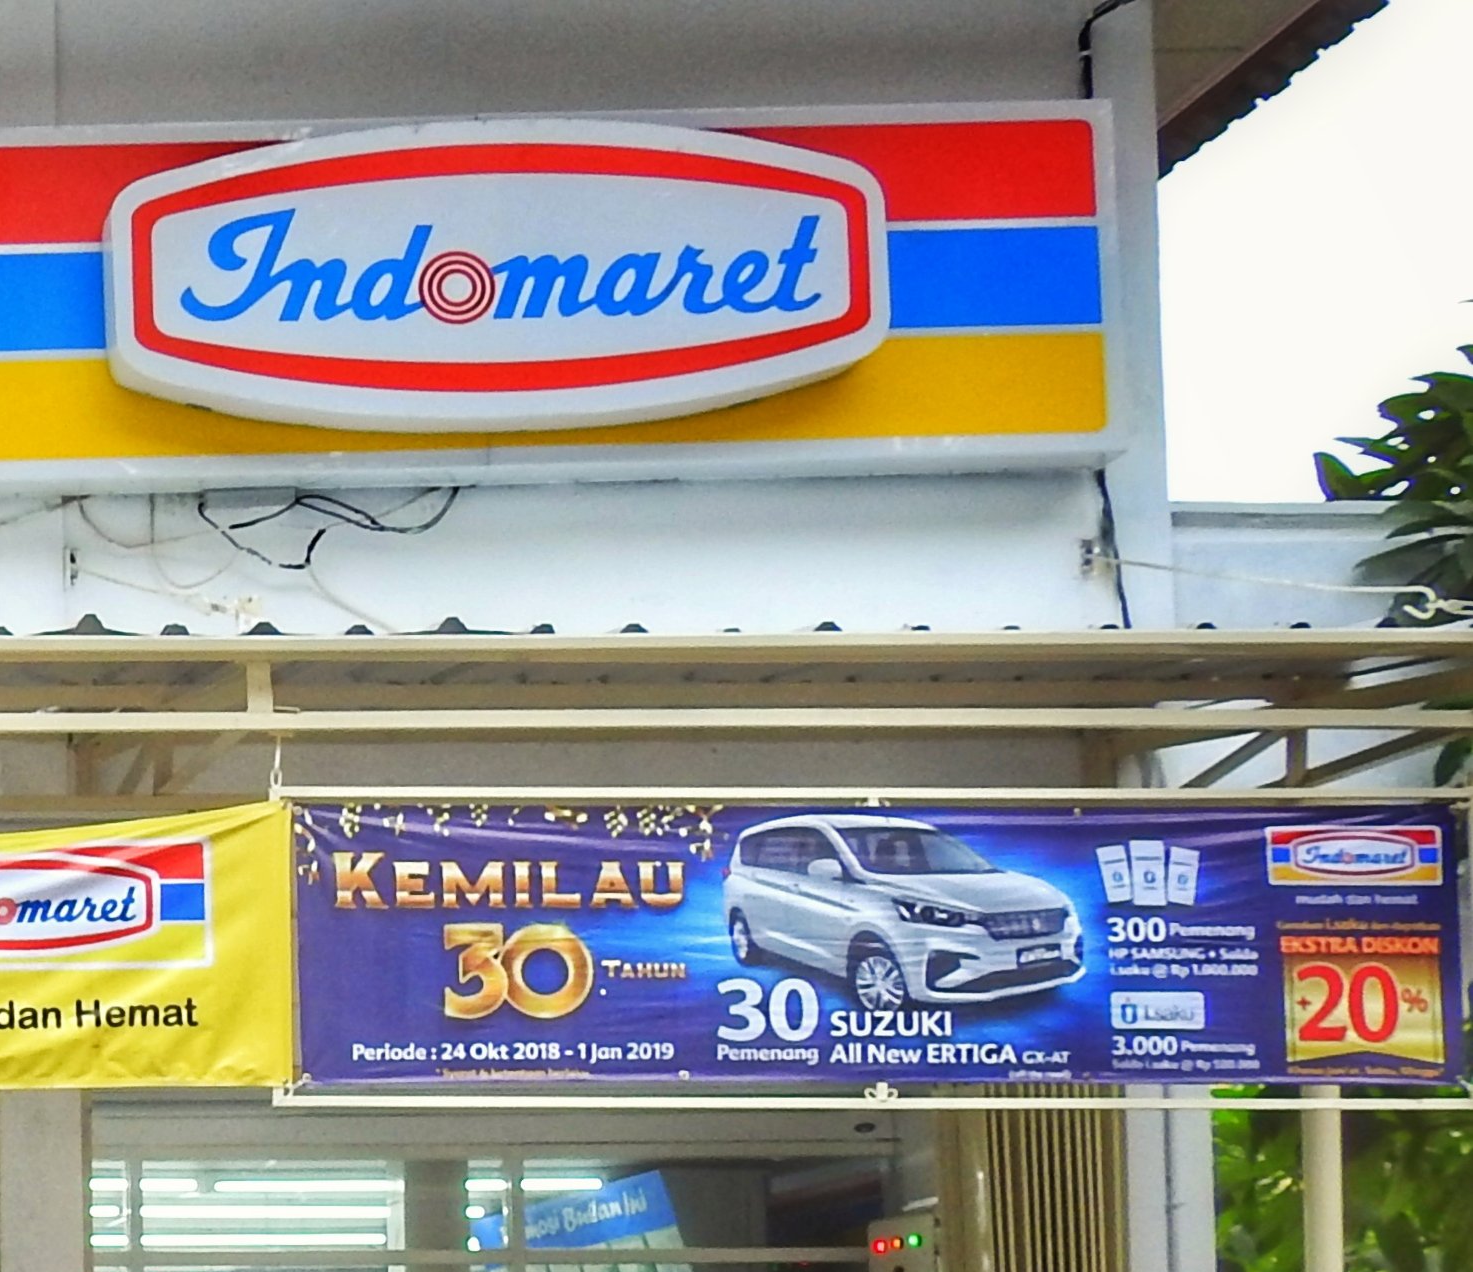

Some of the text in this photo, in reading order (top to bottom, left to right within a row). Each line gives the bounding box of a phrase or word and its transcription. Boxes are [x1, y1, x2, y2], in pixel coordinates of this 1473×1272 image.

[180, 208, 822, 325] Indomaret
[332, 851, 686, 910] KEMILAU
[1107, 916, 1167, 943] 300
[443, 922, 595, 1020] 30
[76, 998, 199, 1029] Hemat
[716, 977, 820, 1042] 30
[830, 1010, 952, 1037] SUZUKI
[352, 1042, 675, 1064] Periode 24 Okt 2018 1 Jan 2019
[716, 1043, 820, 1066] Pemenang
[830, 1044, 863, 1064] All
[867, 1044, 922, 1064] New
[927, 1044, 1016, 1064] ERTIGA
[1112, 1035, 1178, 1056] 3.000
